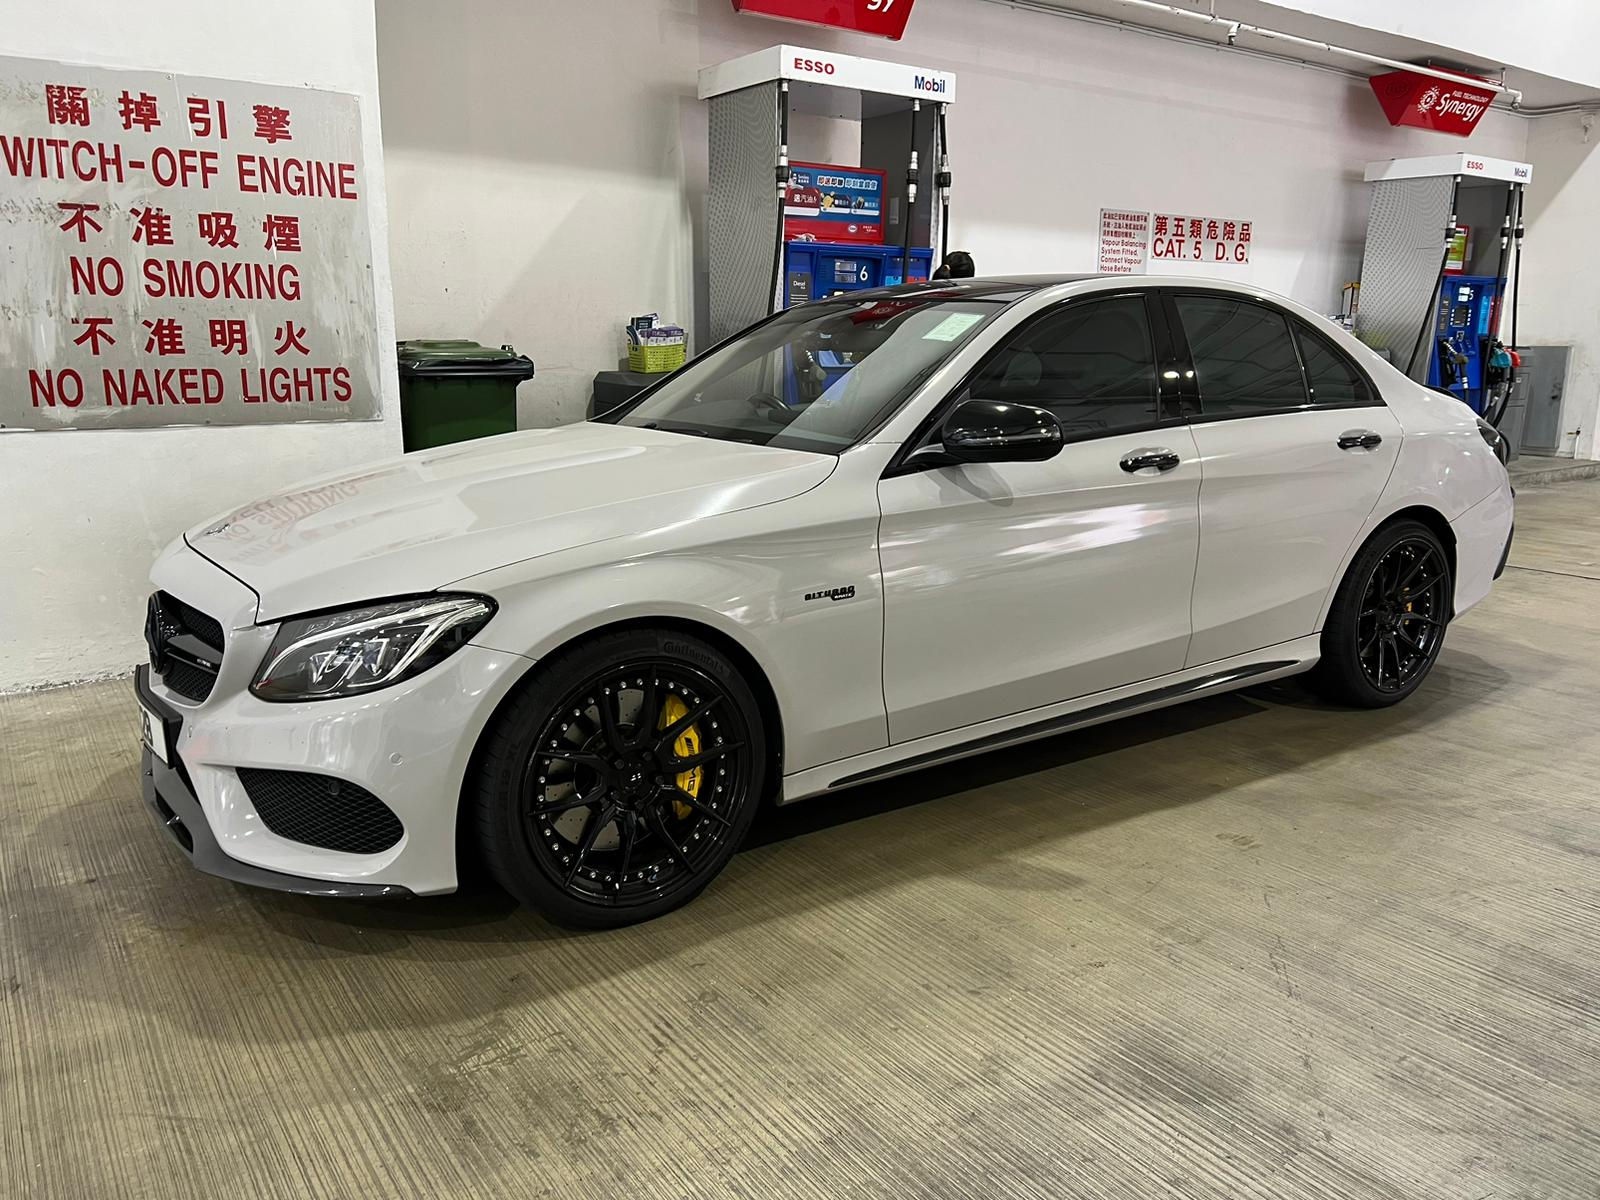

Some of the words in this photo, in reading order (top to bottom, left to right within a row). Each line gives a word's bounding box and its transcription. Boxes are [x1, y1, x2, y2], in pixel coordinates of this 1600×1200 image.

[794, 57, 835, 75] ESSO
[914, 75, 945, 93] Mobil
[45, 84, 293, 144] 關掉引擎
[1436, 93, 1484, 122] Synergy
[0, 135, 219, 189] WITCH-OFF
[237, 153, 358, 200] ENGINE
[1467, 161, 1484, 170] ESSO
[1514, 167, 1528, 178] Mobil
[57, 202, 302, 252] 不准吸煙
[1154, 215, 1251, 242] 第五類危險品
[1101, 247, 1121, 256] System
[1102, 238, 1120, 247] Vapour
[1121, 239, 1146, 250] Balancing
[1153, 237, 1186, 258] CAT.
[1193, 240, 1202, 260] 5
[1100, 264, 1113, 272] Hose
[1101, 255, 1123, 264] Connect
[1124, 257, 1142, 265] Vapour
[70, 255, 124, 297] NO
[143, 258, 301, 301] SMOKING
[860, 265, 868, 281] 6
[73, 316, 311, 356] 不准明火
[28, 368, 84, 408] NO
[102, 367, 225, 407] NAKED
[240, 366, 353, 404] LIGHTS
